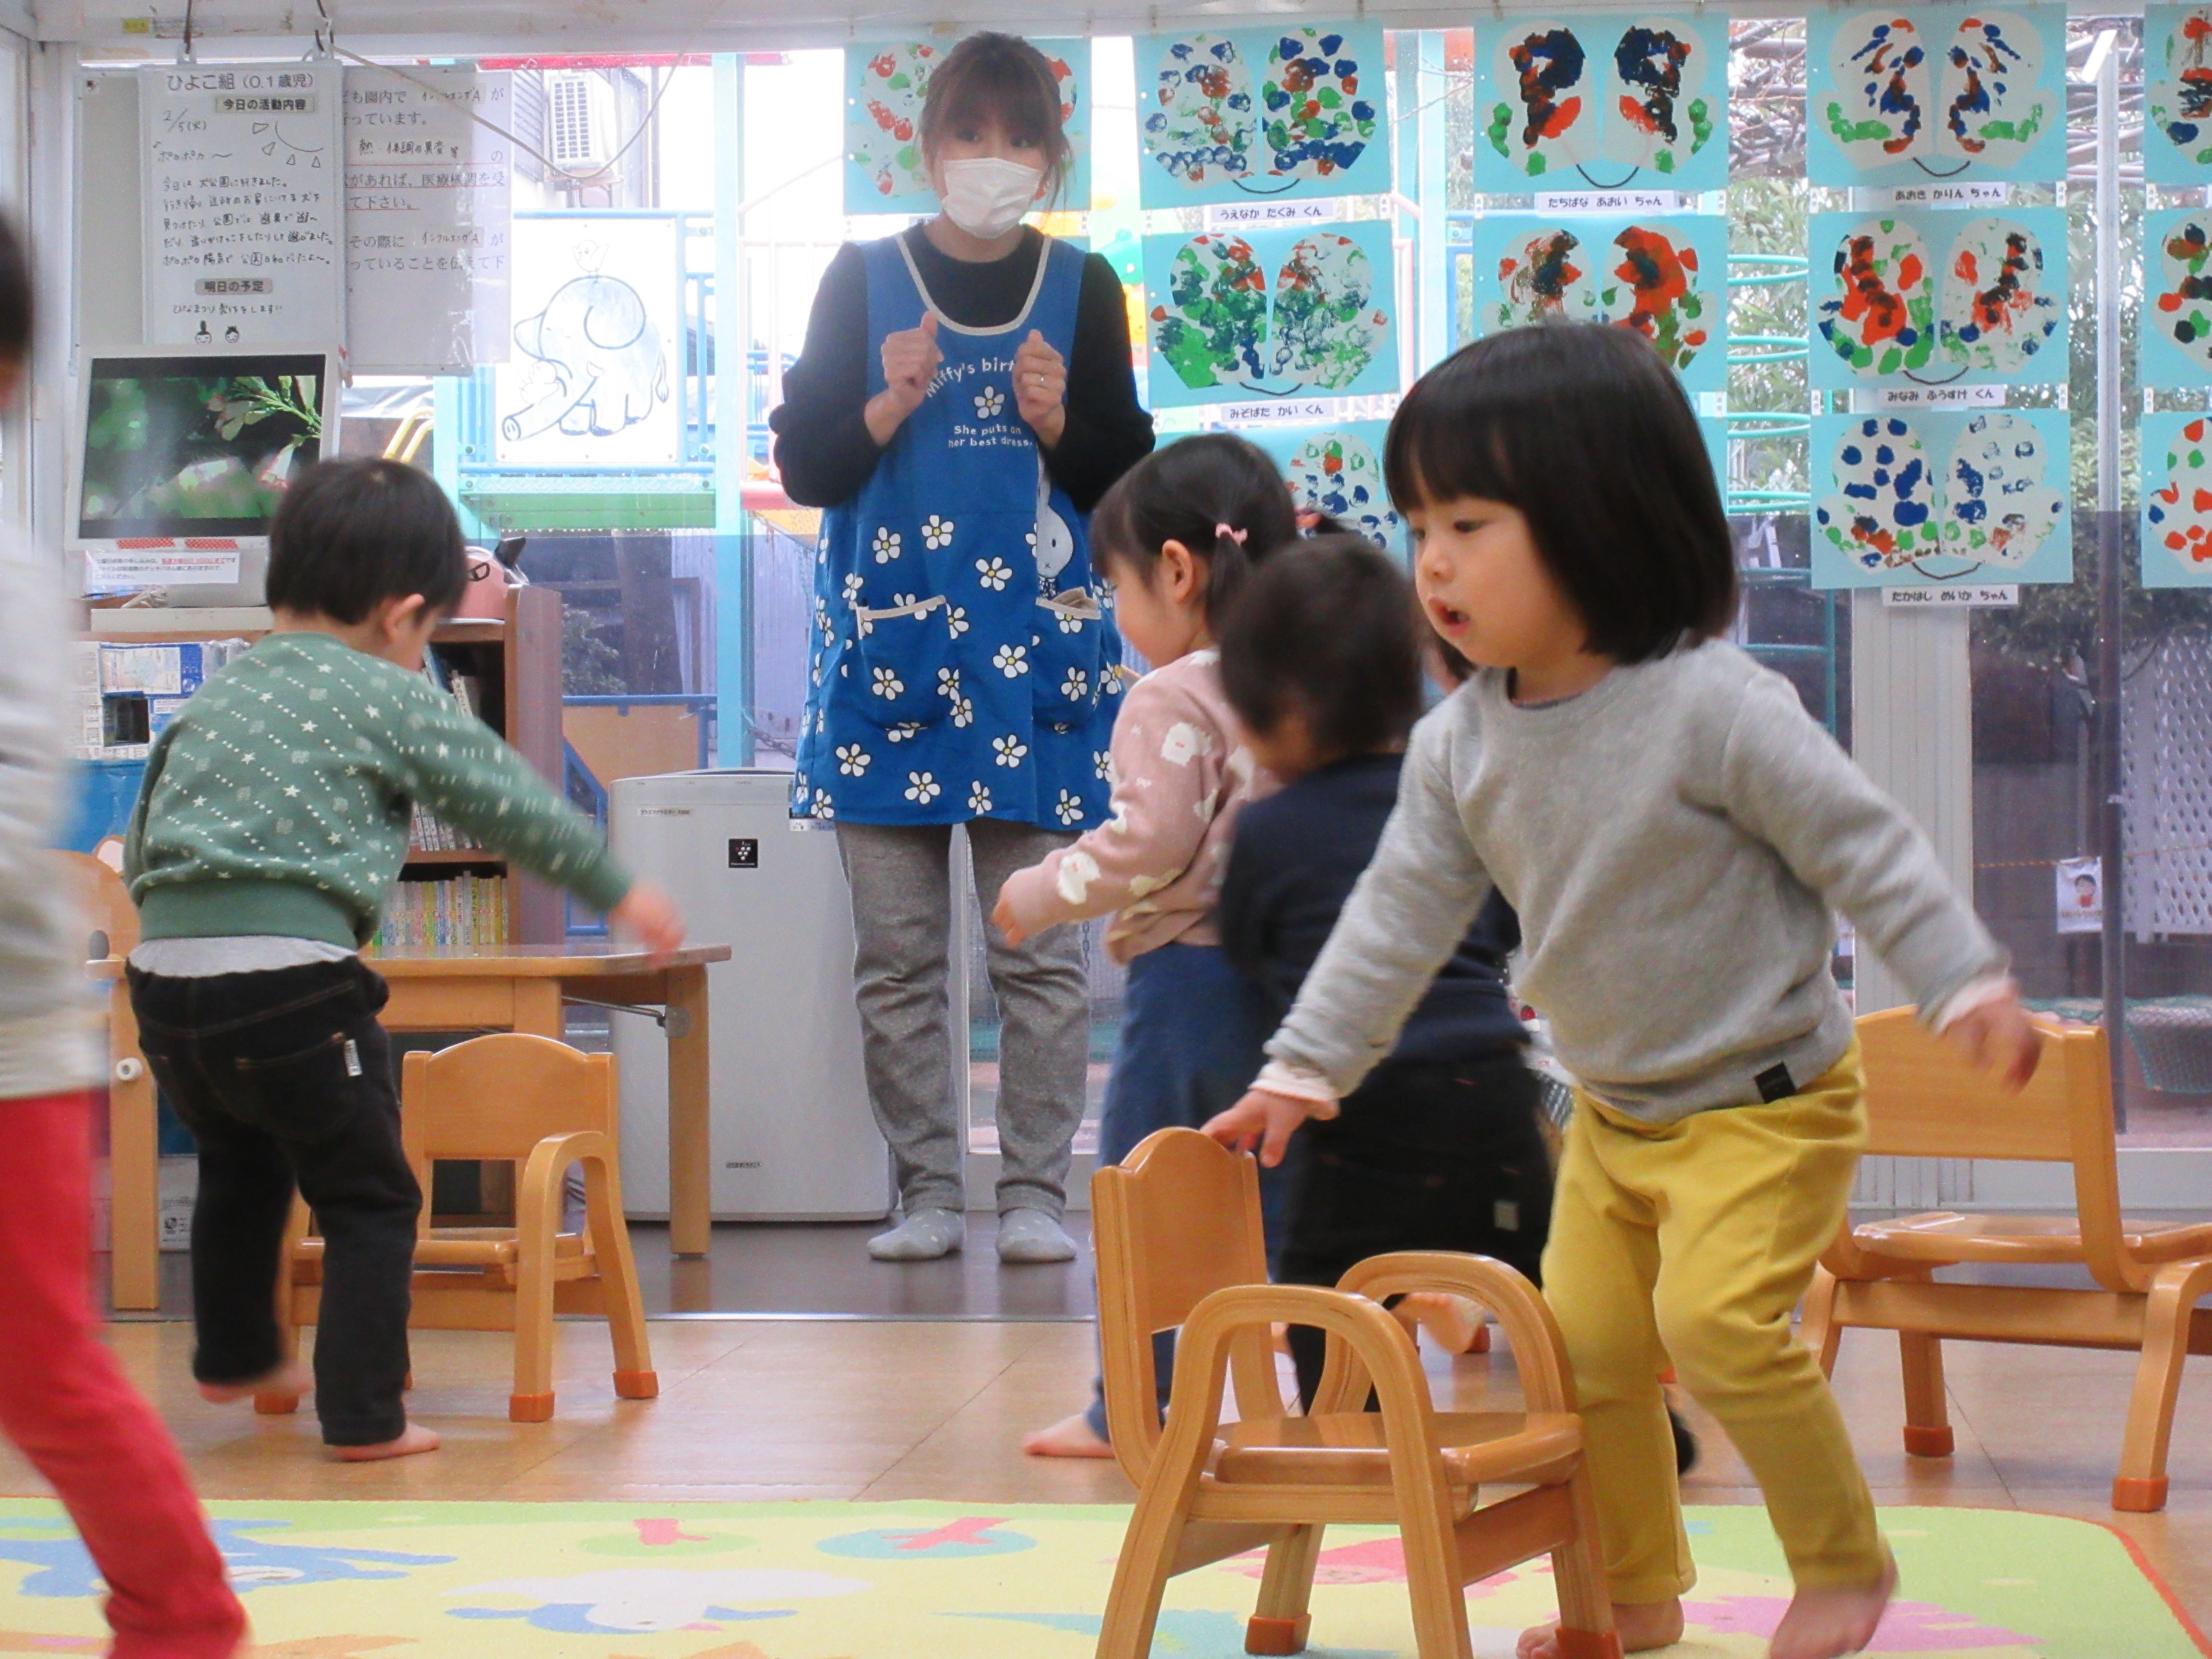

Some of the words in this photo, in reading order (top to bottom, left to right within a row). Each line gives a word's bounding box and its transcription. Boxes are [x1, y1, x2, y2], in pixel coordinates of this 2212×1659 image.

[167, 73, 235, 91] ひよこ組
[223, 99, 306, 111] 今日の活動内容
[1970, 187, 2001, 198] ちゃん
[1548, 197, 1589, 208] たちばな
[1596, 196, 1627, 207] あおい
[1635, 195, 1662, 206] ちゃん
[1221, 209, 1260, 220] うえなか
[1266, 207, 1296, 218] たくみ
[1304, 206, 1322, 216] くん
[204, 280, 264, 292] 明日の予定
[1975, 388, 1994, 399] くん
[1306, 404, 1324, 414] くん
[954, 425, 977, 435] She
[981, 423, 1007, 436] puts
[1010, 426, 1021, 435] on
[969, 437, 997, 447] best
[1979, 590, 2008, 600] ちゃん
